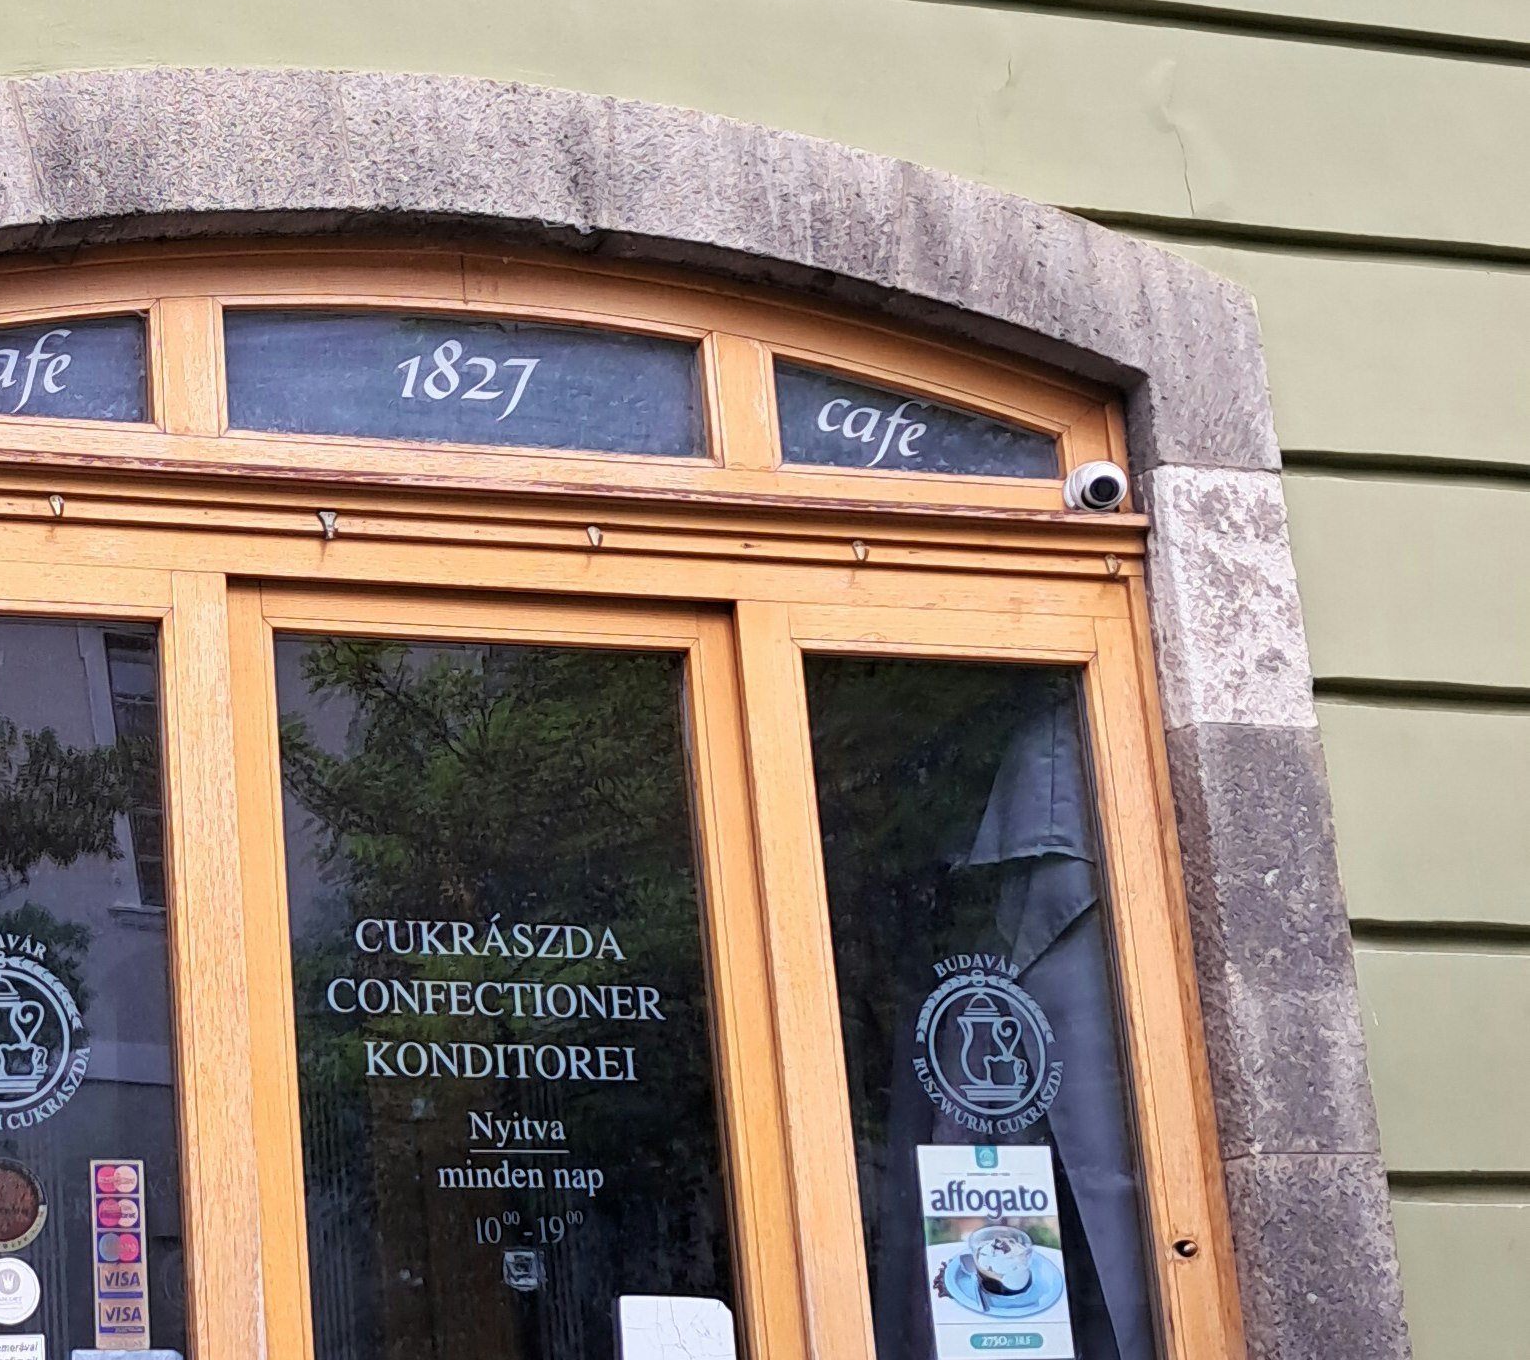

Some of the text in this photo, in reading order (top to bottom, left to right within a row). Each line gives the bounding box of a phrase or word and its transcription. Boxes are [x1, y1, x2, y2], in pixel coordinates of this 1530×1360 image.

[397, 339, 541, 422] 1827
[817, 398, 931, 467] cafe
[355, 913, 627, 960] CUKRÁSZDA
[933, 953, 1020, 979] BUDAVÁR
[327, 978, 666, 1021] CONFECTIONER
[364, 1041, 639, 1081] KONDITOREI
[6, 1047, 91, 1129] CUKRÁSZDA
[912, 1057, 1064, 1135] RUSZWURM CUKRÁSZDA
[468, 1111, 566, 1147] Nyitva
[438, 1160, 604, 1197] minden nap
[930, 1180, 1048, 1219] affogato
[104, 1271, 140, 1287] VISA
[105, 1306, 142, 1322] VISA
